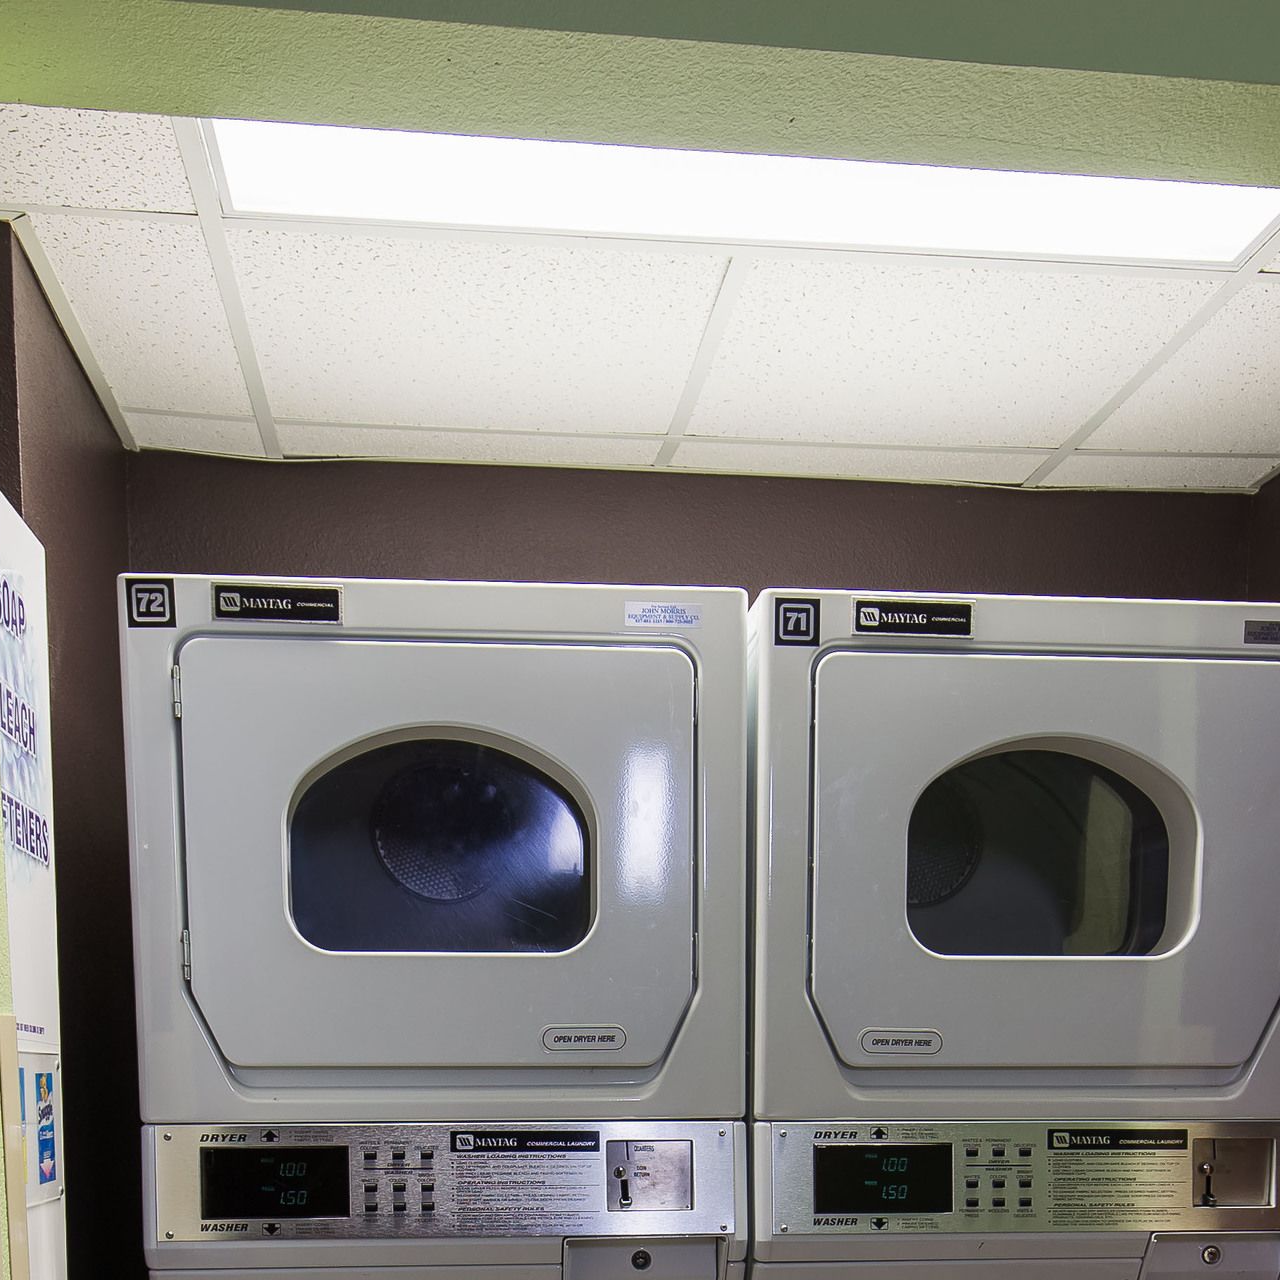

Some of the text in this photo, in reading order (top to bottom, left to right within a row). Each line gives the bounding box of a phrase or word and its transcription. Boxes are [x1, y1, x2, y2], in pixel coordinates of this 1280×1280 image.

[137, 592, 164, 612] 72
[242, 597, 292, 611] MAYTAG
[785, 611, 808, 630] 71
[880, 612, 927, 625] MAYTAG
[553, 1033, 616, 1044] OPEN DRYER HERE
[871, 1038, 932, 1048] OPEN DRYER HERE
[200, 1134, 247, 1142] DRYER
[814, 1131, 858, 1139] DRYER
[475, 1138, 517, 1147] MAYTAG
[1071, 1136, 1111, 1145] MAYTAG
[813, 1218, 858, 1226] WASHER
[200, 1223, 249, 1232] WASHER
